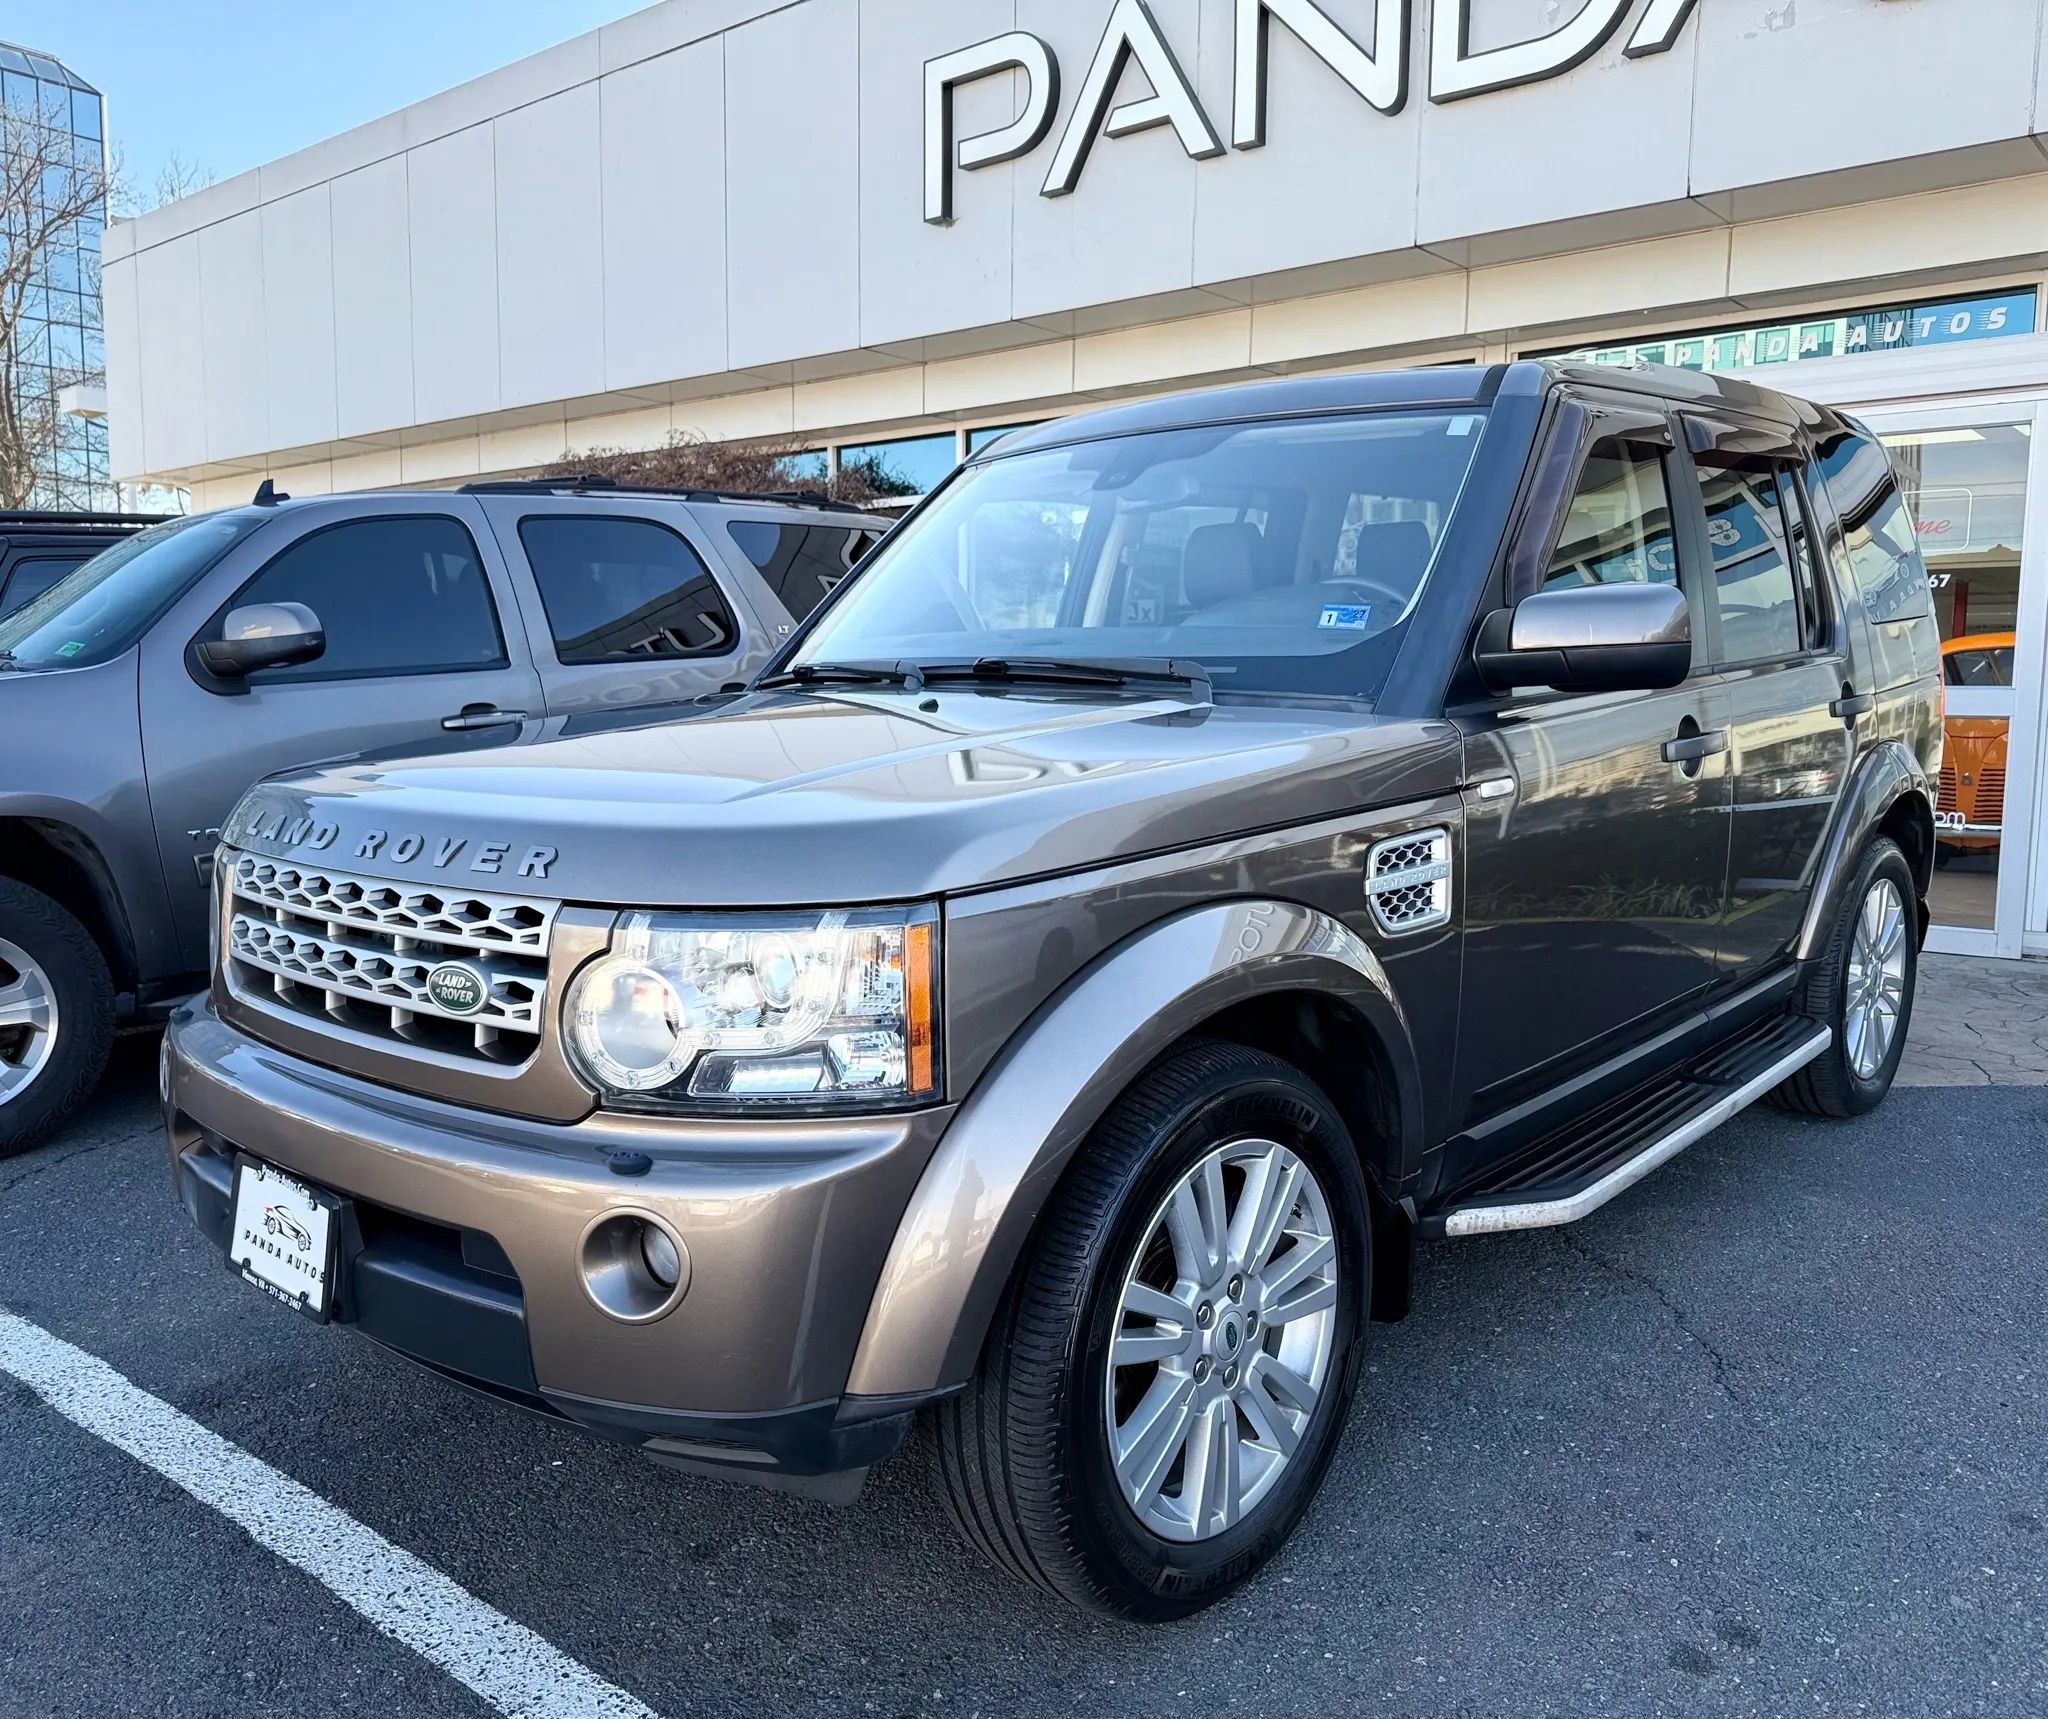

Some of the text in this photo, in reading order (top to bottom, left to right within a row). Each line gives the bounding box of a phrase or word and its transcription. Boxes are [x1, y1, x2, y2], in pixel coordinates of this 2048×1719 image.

[923, 0, 1700, 225] PAN
[1675, 306, 2008, 367] PANDA AUTOS
[778, 624, 789, 634] LT
[246, 810, 558, 878] LAND ROVER
[438, 973, 466, 989] LAND
[440, 986, 474, 1004] ROVER
[243, 1230, 325, 1283] PANDA AUTOS
